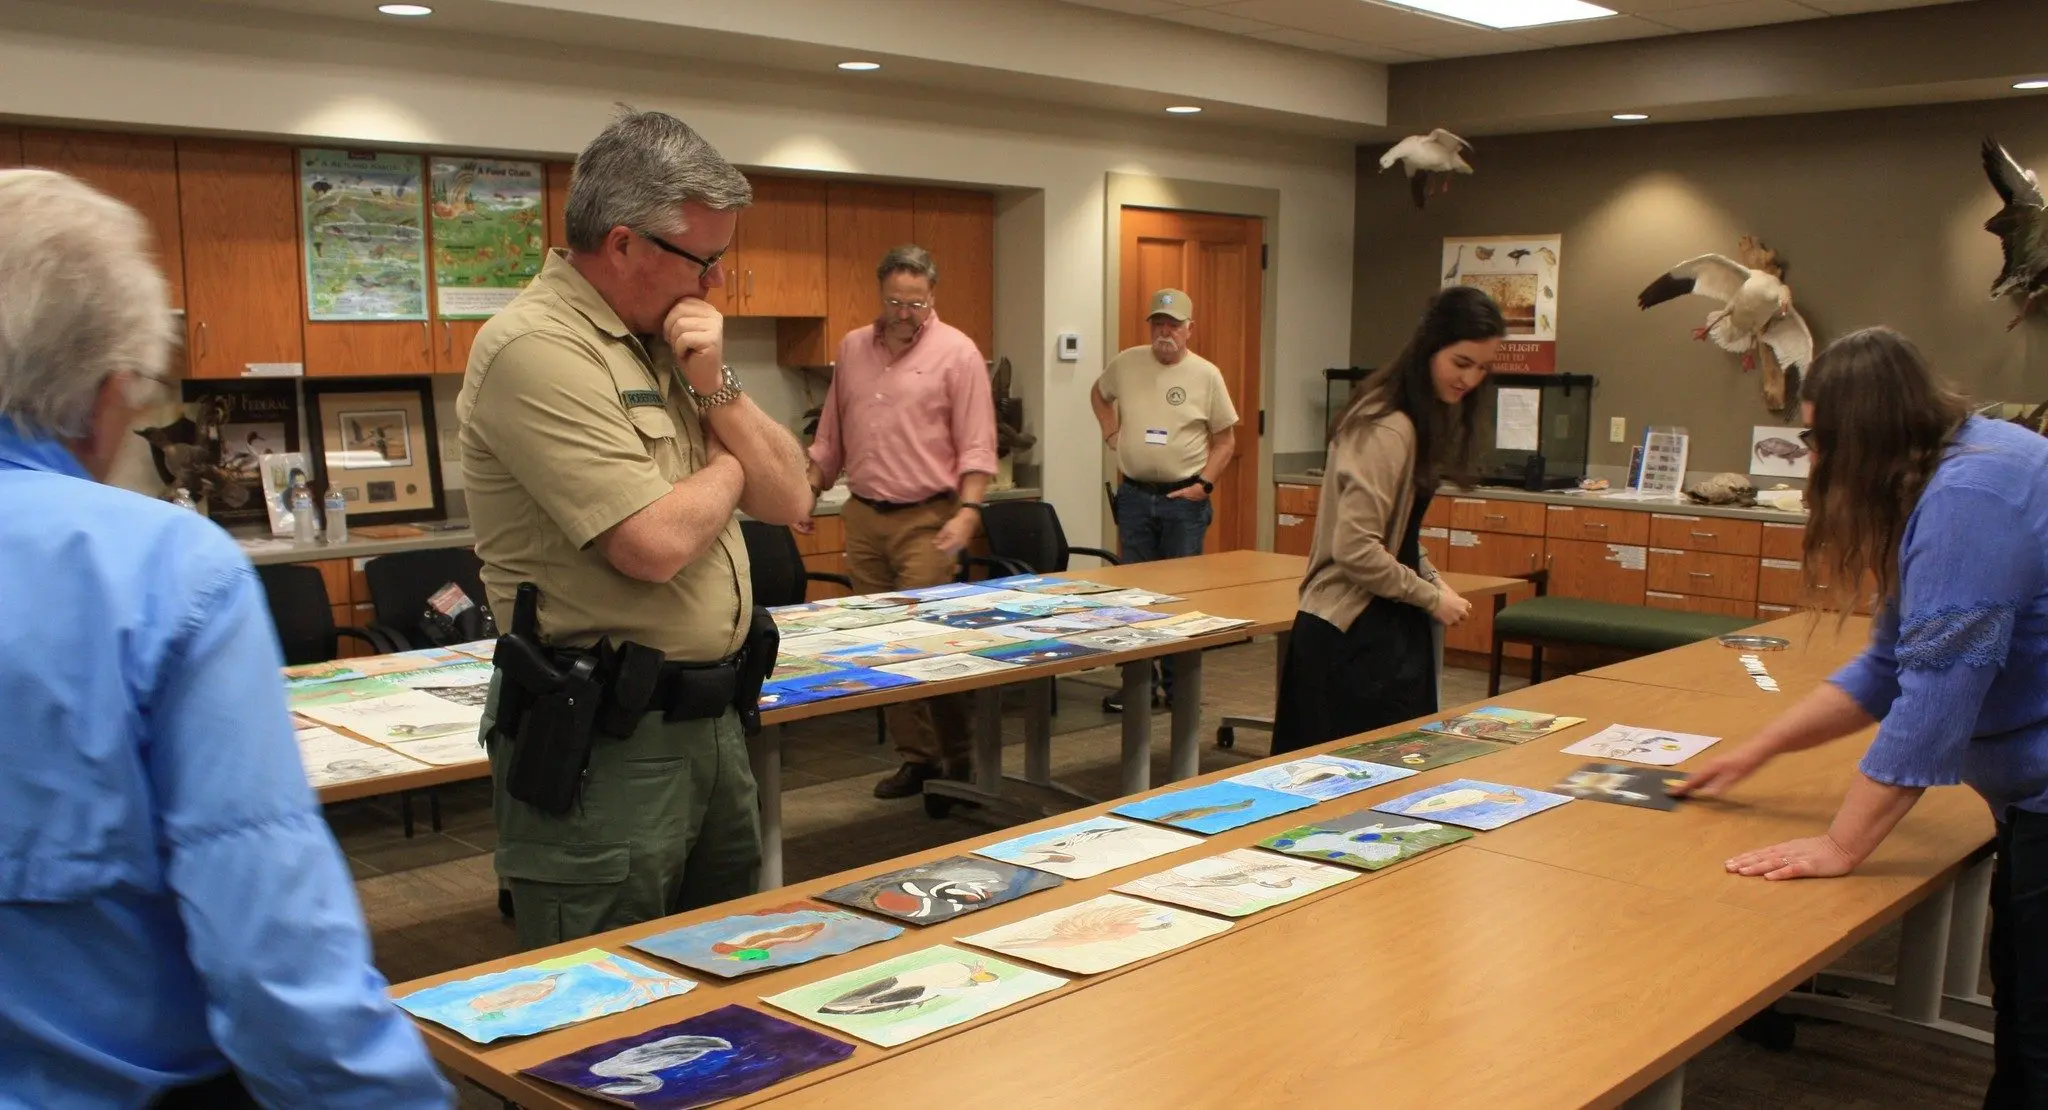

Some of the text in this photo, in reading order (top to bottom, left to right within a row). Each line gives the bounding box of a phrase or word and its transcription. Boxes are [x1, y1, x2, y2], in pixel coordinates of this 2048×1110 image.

[477, 167, 532, 177] A Food Chain
[1508, 343, 1540, 352] FLIGHT
